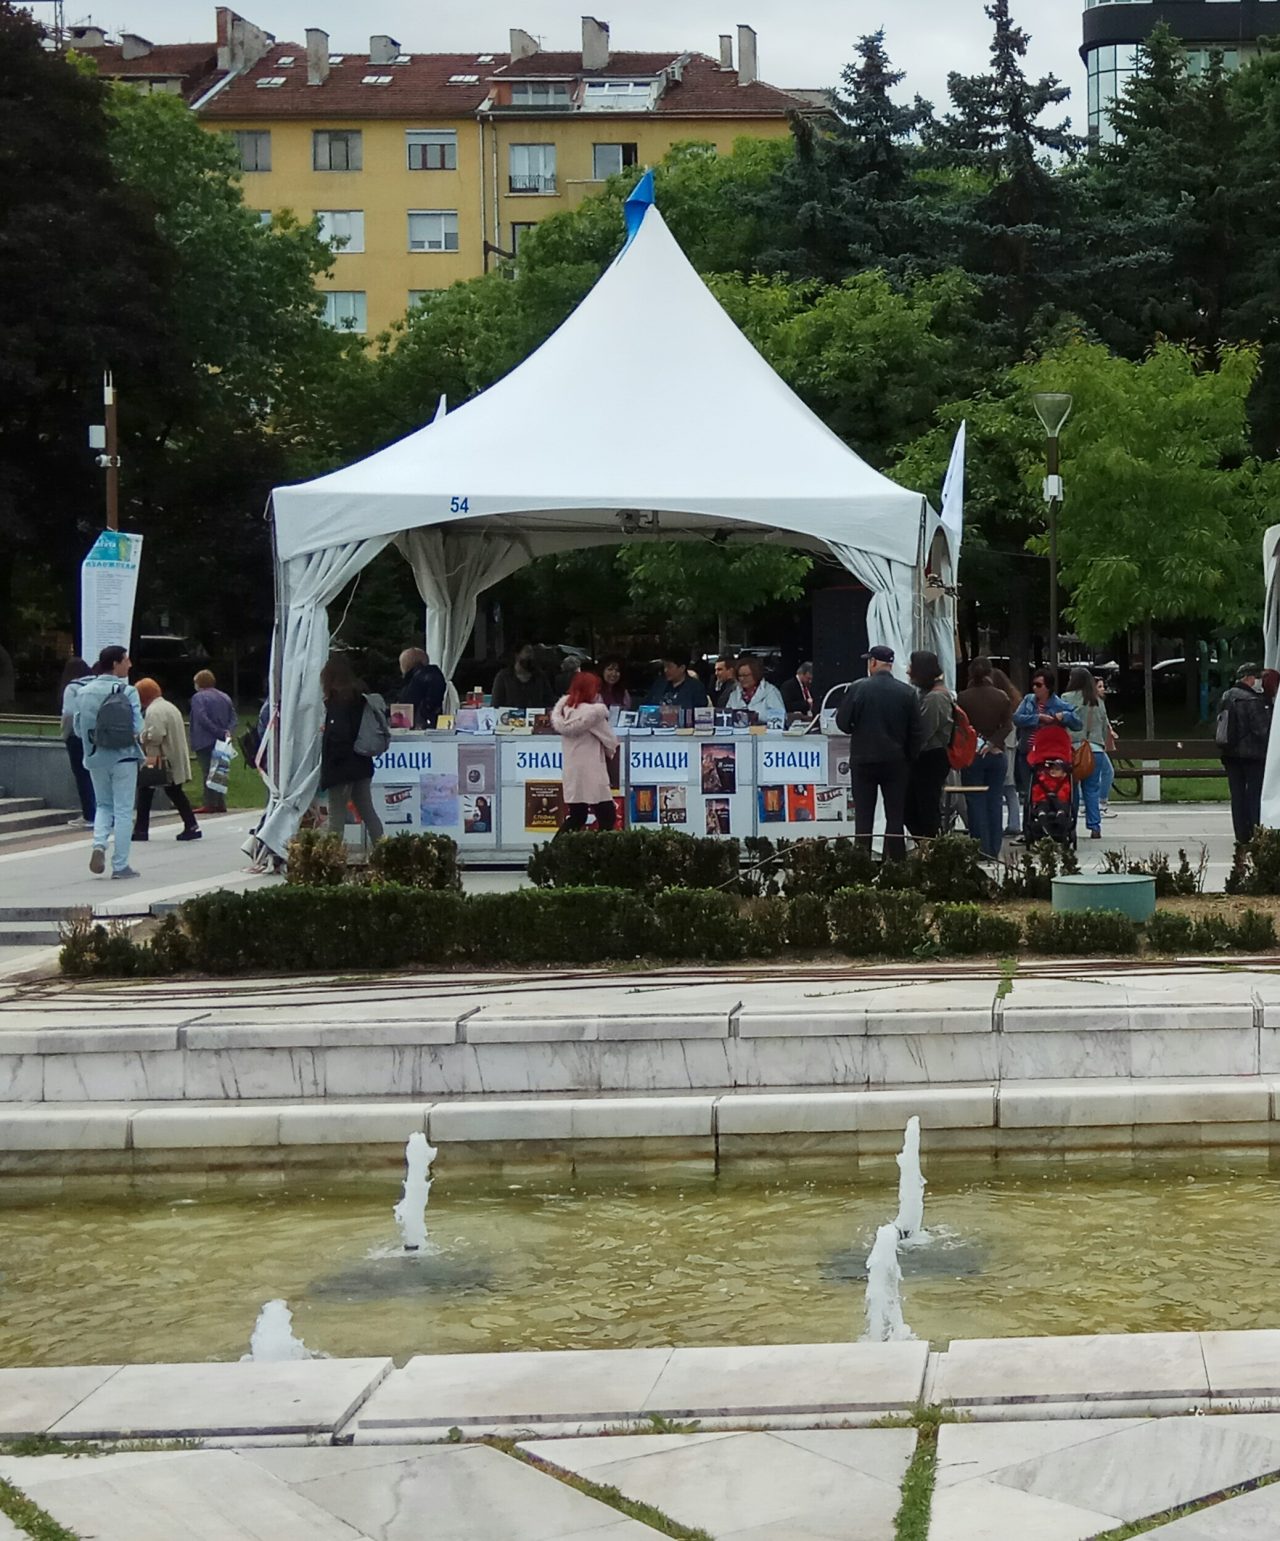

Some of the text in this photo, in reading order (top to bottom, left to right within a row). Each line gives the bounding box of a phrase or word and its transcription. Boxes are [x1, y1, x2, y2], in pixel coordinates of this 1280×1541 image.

[450, 496, 470, 514] 54
[372, 751, 432, 771] ЗНАЦИ
[516, 751, 563, 770] ЗНАЦ
[630, 751, 688, 770] ЗНАЦИ
[763, 751, 820, 770] ЗНАЦИ
